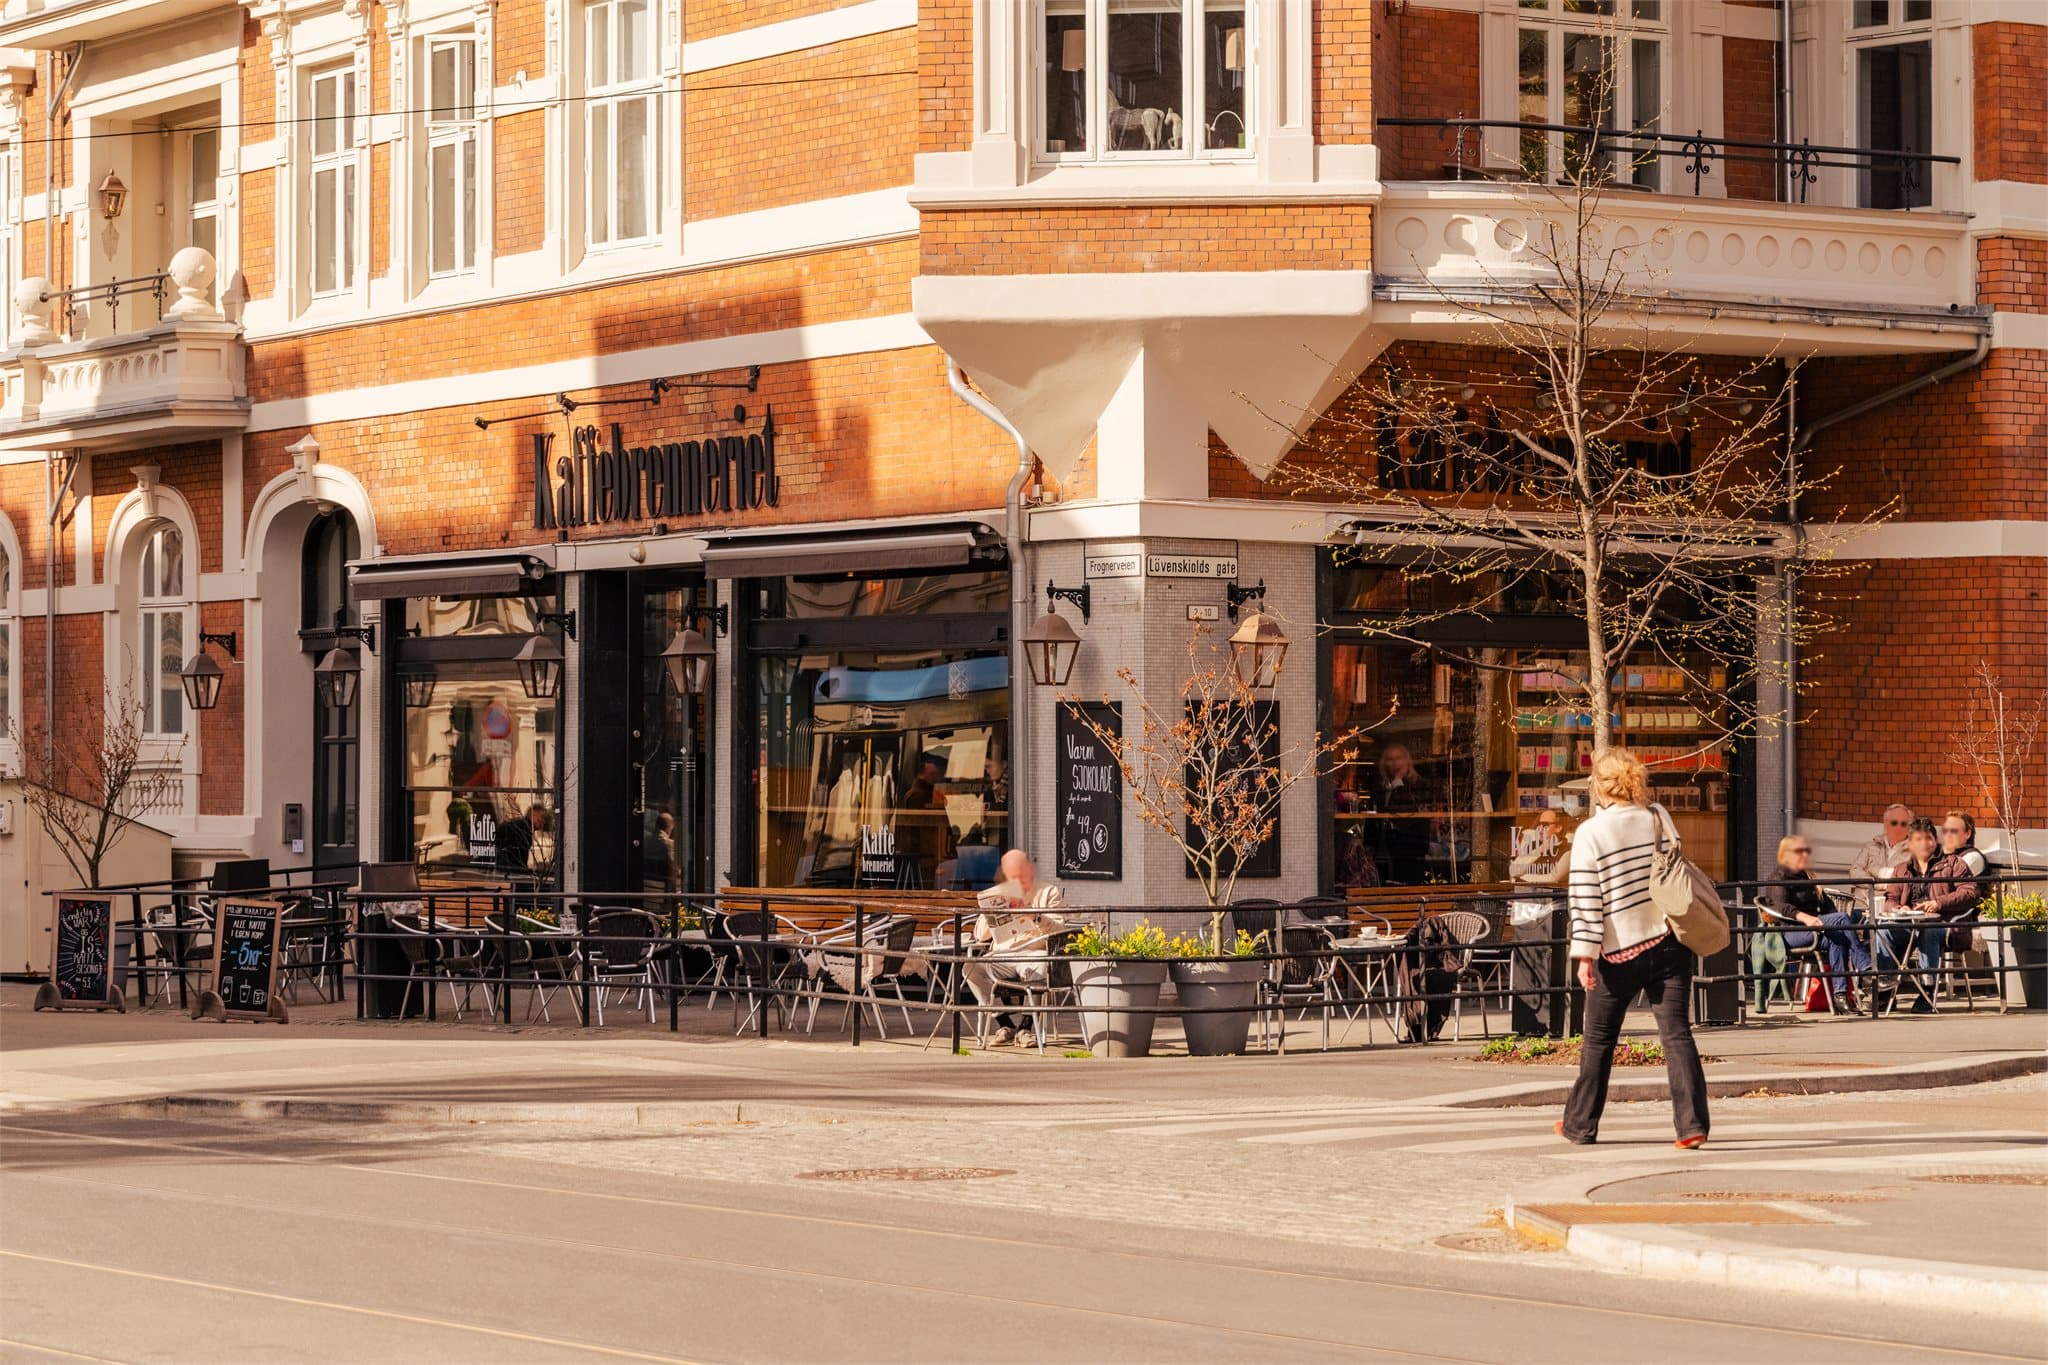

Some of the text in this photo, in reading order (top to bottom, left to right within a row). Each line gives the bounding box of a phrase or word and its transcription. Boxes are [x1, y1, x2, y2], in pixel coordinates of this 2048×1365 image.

[533, 403, 779, 530] Kaffebrenneriet
[1090, 560, 1135, 574] Frognerveien
[1216, 560, 1236, 576] gate
[1067, 734, 1095, 760] Varm
[1072, 764, 1112, 793] SJOKOLADE
[470, 813, 496, 841] Kaffe
[862, 824, 895, 855] Kaffe
[1510, 825, 1559, 857] Kaffe
[862, 856, 895, 872] brenneriet
[1510, 859, 1559, 875] nnerie
[233, 920, 246, 928] ALLE
